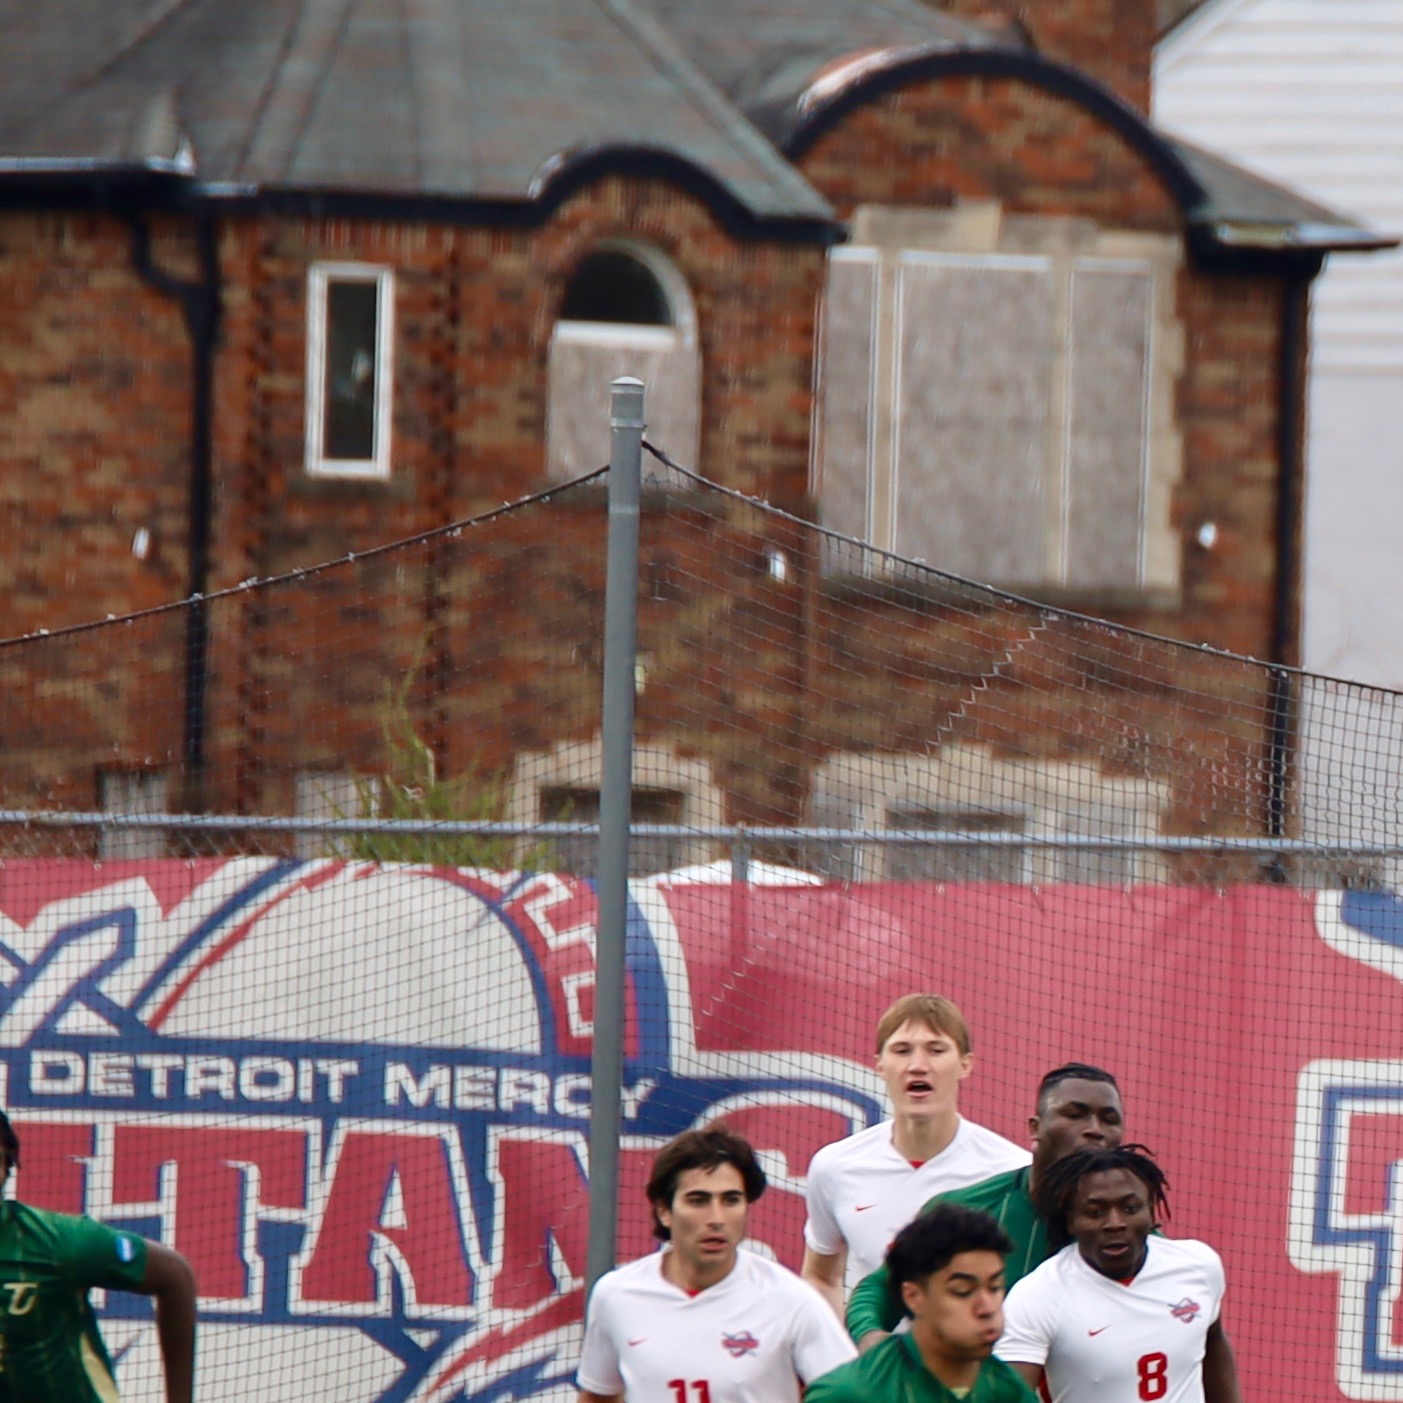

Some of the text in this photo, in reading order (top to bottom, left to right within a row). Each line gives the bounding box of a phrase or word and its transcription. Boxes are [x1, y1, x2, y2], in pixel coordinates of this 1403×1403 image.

[30, 1050, 657, 1120] DETROIT MERCY
[1136, 1351, 1169, 1402] 8
